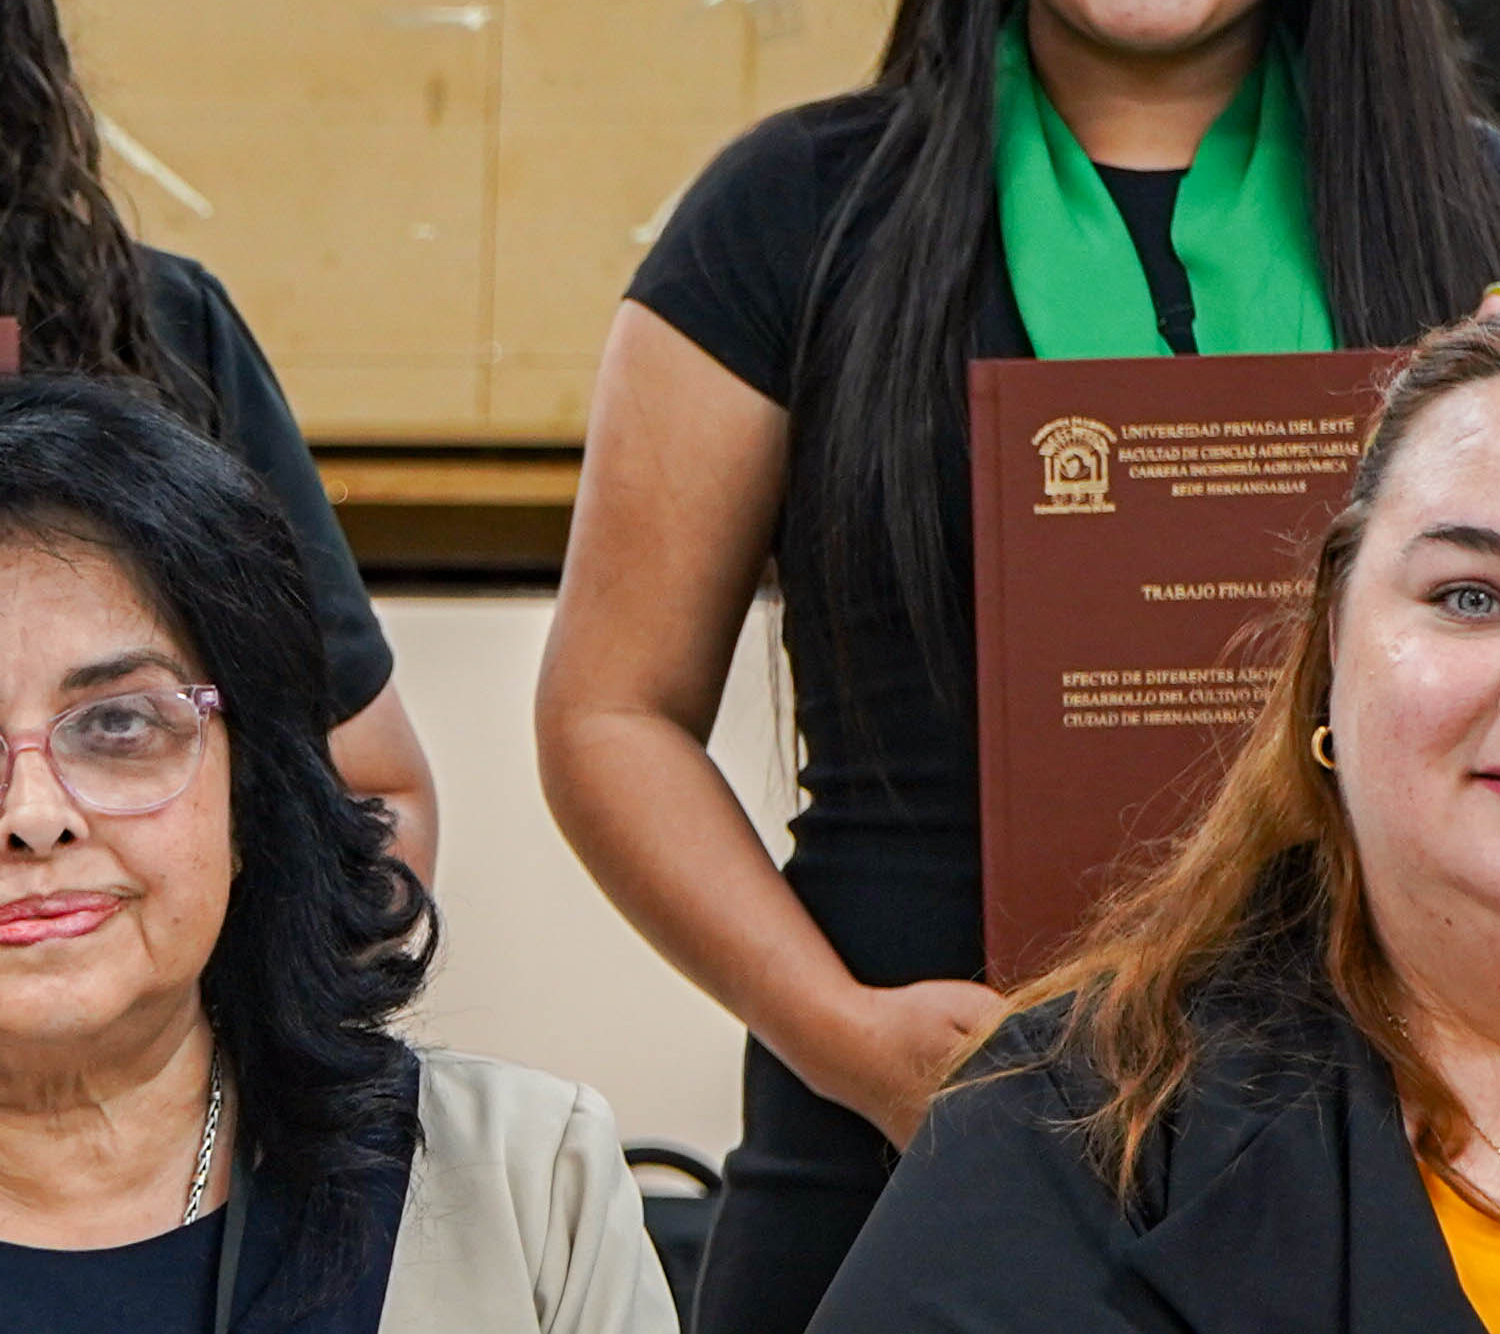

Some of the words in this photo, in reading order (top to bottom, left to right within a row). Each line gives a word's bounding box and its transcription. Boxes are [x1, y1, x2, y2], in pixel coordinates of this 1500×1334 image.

[1120, 422, 1221, 440] UNIVERSIDAD
[1223, 421, 1287, 438] PRIVADA
[1288, 420, 1318, 436] DEL
[1320, 418, 1355, 435] ESTE
[1118, 446, 1180, 463] FACULTAD
[1181, 446, 1199, 461] DE
[1201, 444, 1257, 461] CIENCIAS
[1258, 441, 1360, 459] AGROPECUARIAS
[1129, 464, 1188, 479] CARRERA
[1171, 482, 1204, 497] SEDE
[1206, 479, 1307, 496] HERNANDARIAS
[1142, 583, 1216, 602] TRABAJO
[1218, 581, 1267, 600] FINAL
[1270, 580, 1293, 598] DE
[1062, 670, 1119, 687] EFECTO
[1121, 670, 1142, 686] DE
[1145, 668, 1234, 685] DIFERENTES
[1062, 690, 1157, 708] DESARROLLO
[1158, 690, 1187, 706] DEL
[1188, 687, 1250, 705] CULTIVO
[1062, 712, 1120, 728] CIUDAD
[1121, 711, 1142, 727] DE
[1143, 708, 1255, 726] HERNANDARIAS
